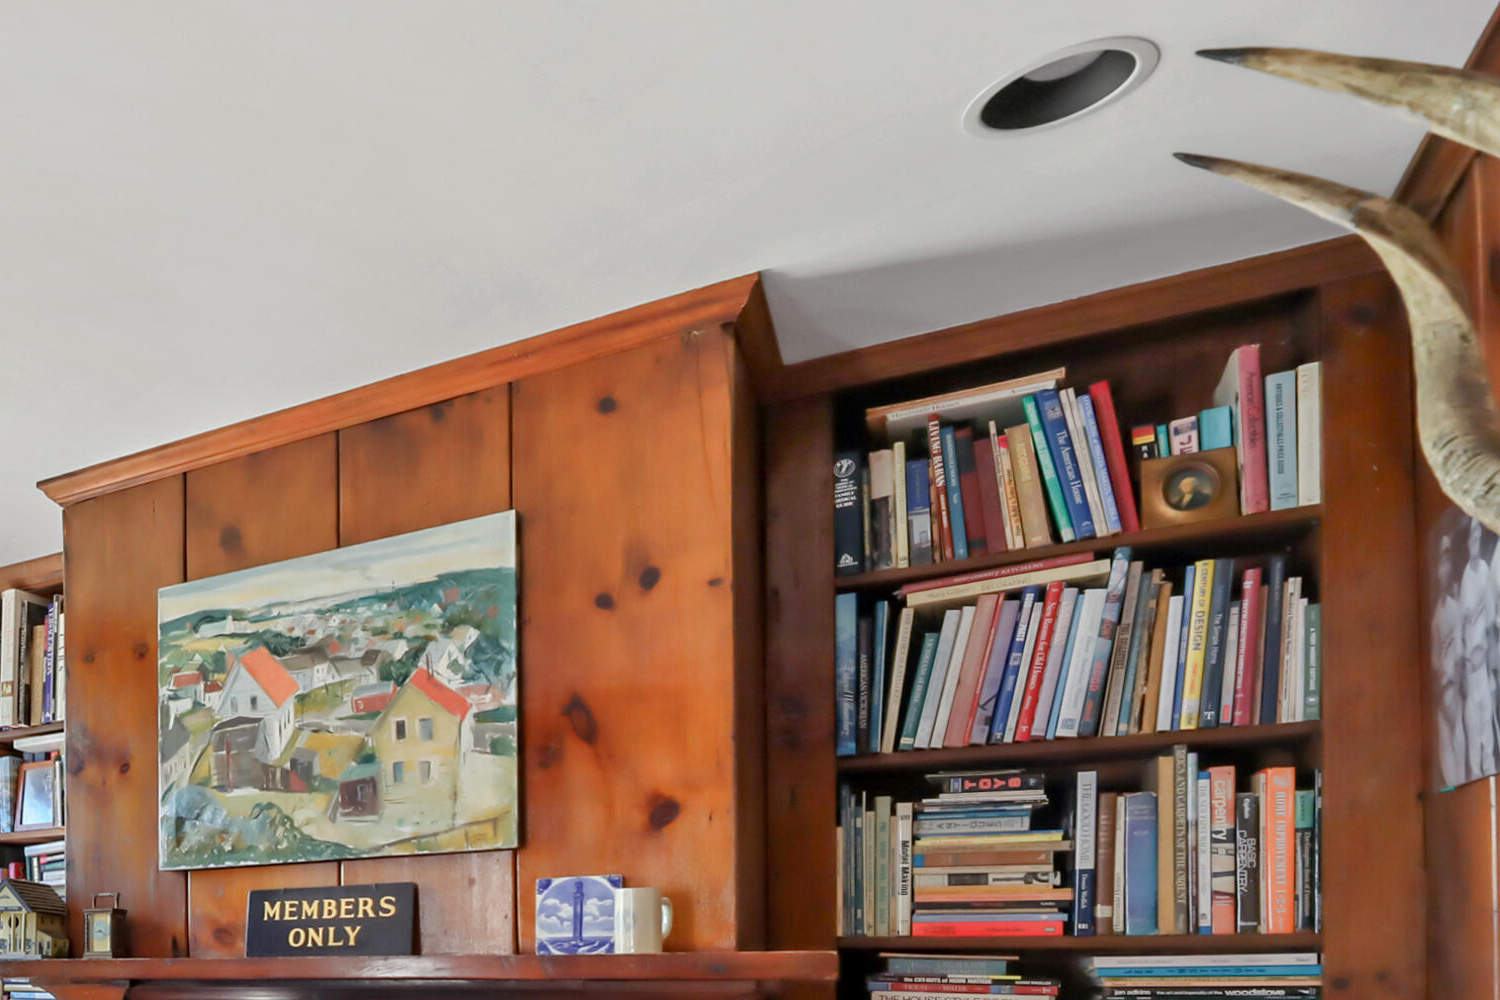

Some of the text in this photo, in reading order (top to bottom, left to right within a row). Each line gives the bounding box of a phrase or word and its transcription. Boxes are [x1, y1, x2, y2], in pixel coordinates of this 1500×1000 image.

[928, 420, 946, 488] LIVING BARNS
[1056, 430, 1085, 505] The American House
[1192, 610, 1206, 651] DESIGN
[1211, 780, 1228, 840] carpentry
[1247, 838, 1256, 868] BASIC
[263, 895, 397, 921] MEMBERS
[288, 926, 362, 948] ONLY
